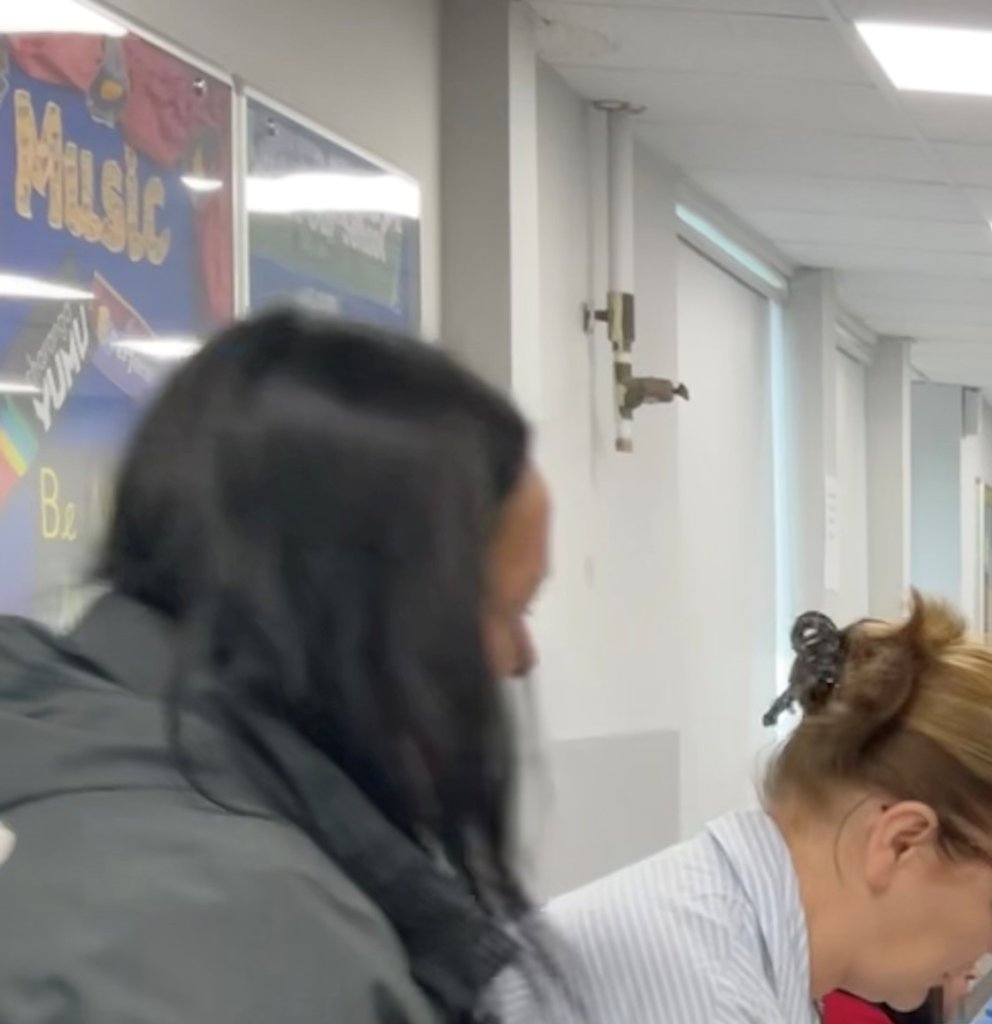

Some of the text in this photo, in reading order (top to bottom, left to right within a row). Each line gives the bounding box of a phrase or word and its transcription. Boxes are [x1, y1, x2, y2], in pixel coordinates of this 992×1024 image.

[14, 88, 172, 266] Music
[32, 304, 90, 432] YUMU
[40, 466, 78, 541] Be
